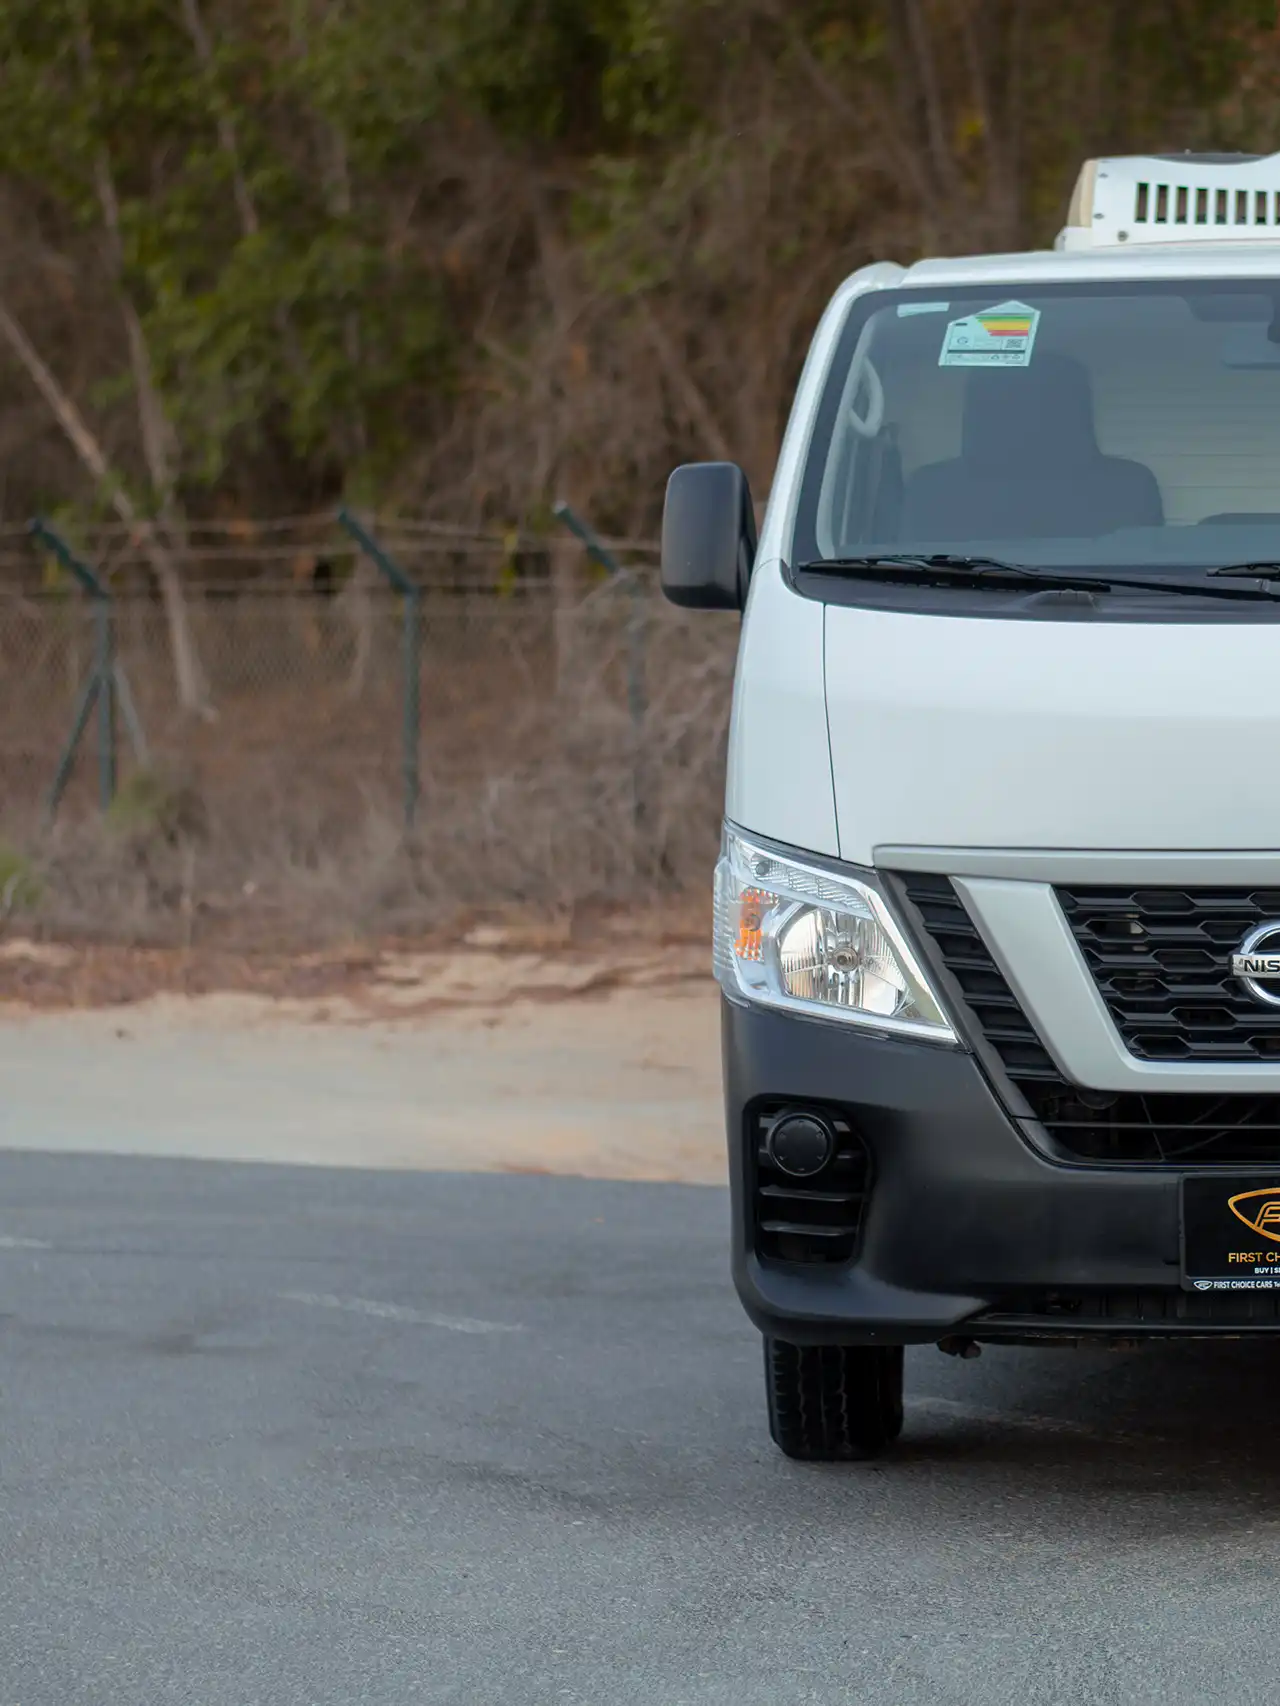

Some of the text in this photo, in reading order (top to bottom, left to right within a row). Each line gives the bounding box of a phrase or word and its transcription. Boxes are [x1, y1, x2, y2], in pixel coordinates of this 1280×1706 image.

[1228, 1252, 1263, 1263] FIRST
[1213, 1281, 1230, 1289] FIRST
[1230, 1280, 1255, 1289] CHOICE
[1255, 1280, 1273, 1289] CARS
